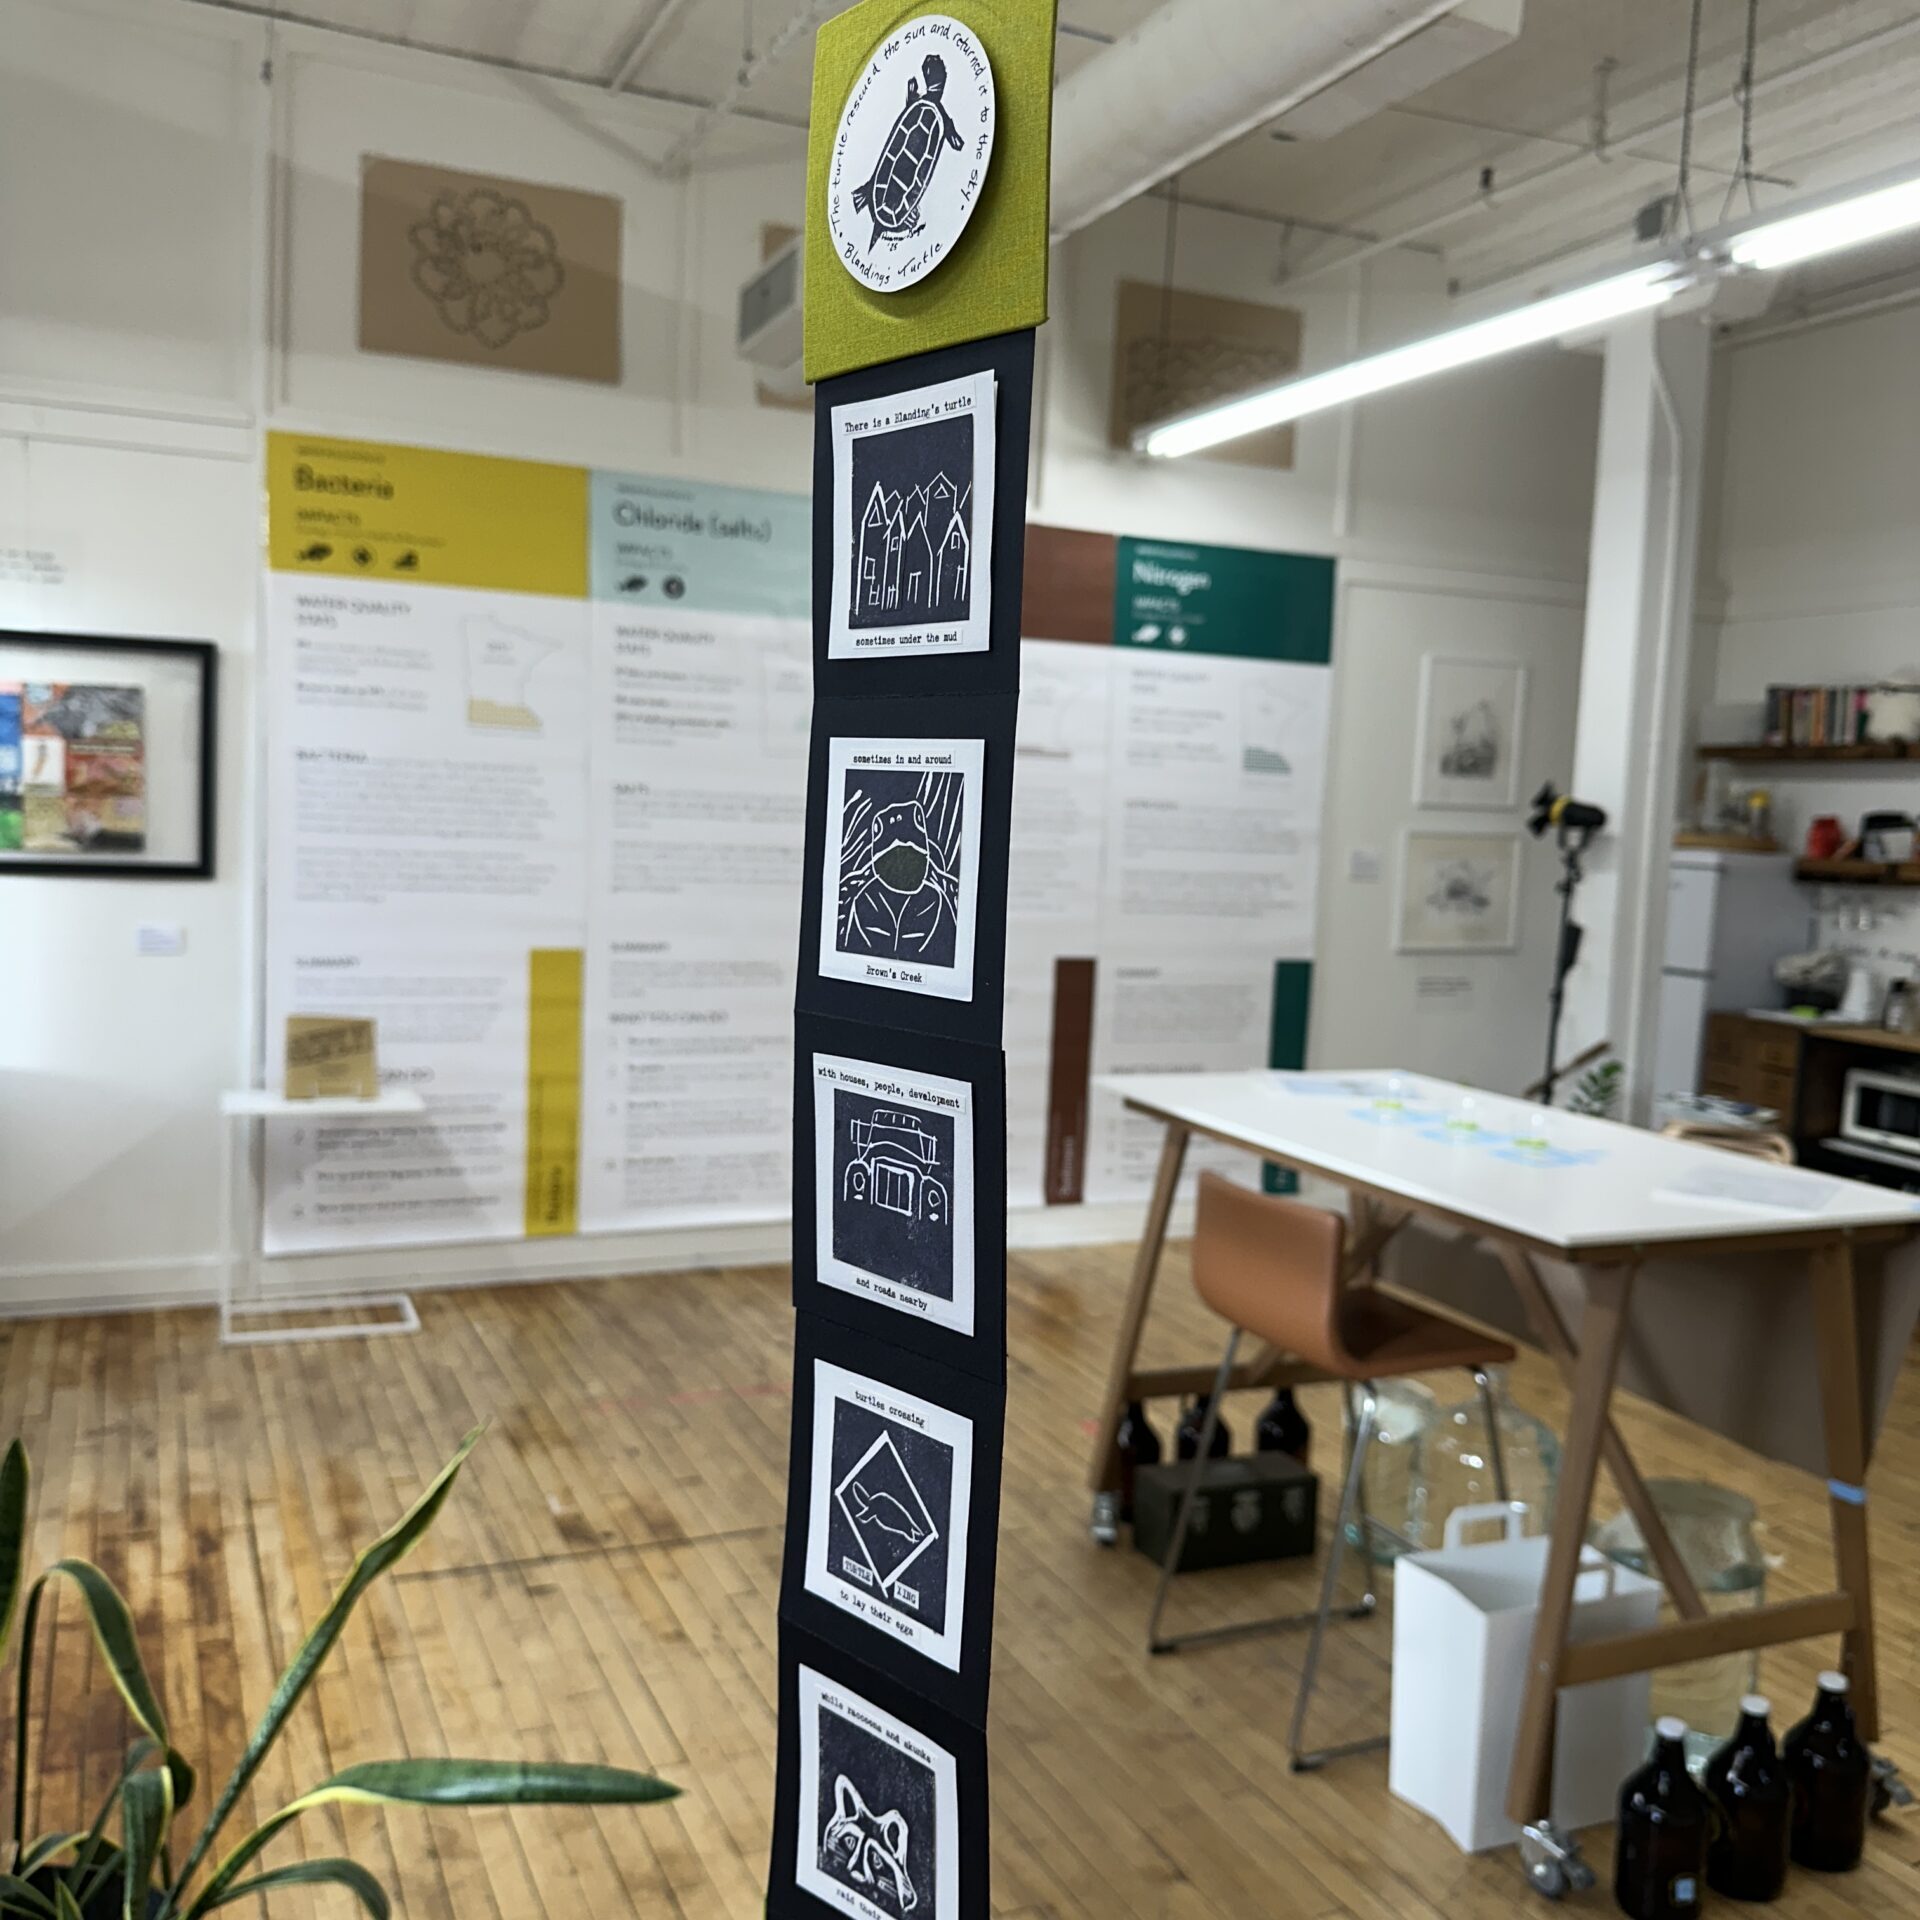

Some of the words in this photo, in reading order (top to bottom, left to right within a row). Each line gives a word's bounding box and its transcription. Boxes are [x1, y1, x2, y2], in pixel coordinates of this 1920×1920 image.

[904, 25, 926, 44] sun
[930, 23, 951, 40] and
[884, 41, 900, 60] the
[952, 32, 987, 80] returned
[846, 63, 881, 126] rescued
[978, 80, 989, 96] it
[980, 106, 990, 123] to
[832, 131, 848, 186] turtle
[975, 133, 989, 160] the
[830, 194, 841, 234] The
[897, 242, 943, 277] Turtle
[844, 422, 869, 433] There
[873, 417, 882, 428] is
[894, 403, 940, 423] Blanding's
[944, 396, 972, 411] turtle
[855, 635, 896, 647] sometimes
[899, 634, 922, 645] under
[926, 632, 940, 643] the
[943, 631, 958, 642] mud
[853, 754, 892, 765] sometimes
[895, 754, 905, 764] in
[907, 754, 922, 765] and
[925, 755, 952, 765] around
[866, 965, 897, 980] Brown's
[900, 971, 923, 983] Creek
[817, 1067, 837, 1079] with
[840, 1071, 870, 1088] houses,
[874, 1081, 904, 1098] people,
[909, 1089, 960, 1109] development
[856, 1276, 870, 1288] and
[873, 1283, 897, 1299] roads
[900, 1294, 928, 1311] nearby
[855, 1391, 885, 1411] turtles
[889, 1406, 926, 1429] crossing
[844, 1560, 872, 1582] TURTLE
[896, 1585, 917, 1604] XING
[840, 1590, 849, 1601] to
[853, 1595, 867, 1611] lay
[870, 1605, 892, 1623] their
[896, 1621, 914, 1637] eggs
[886, 1729, 900, 1744] and
[904, 1740, 931, 1764] skunks
